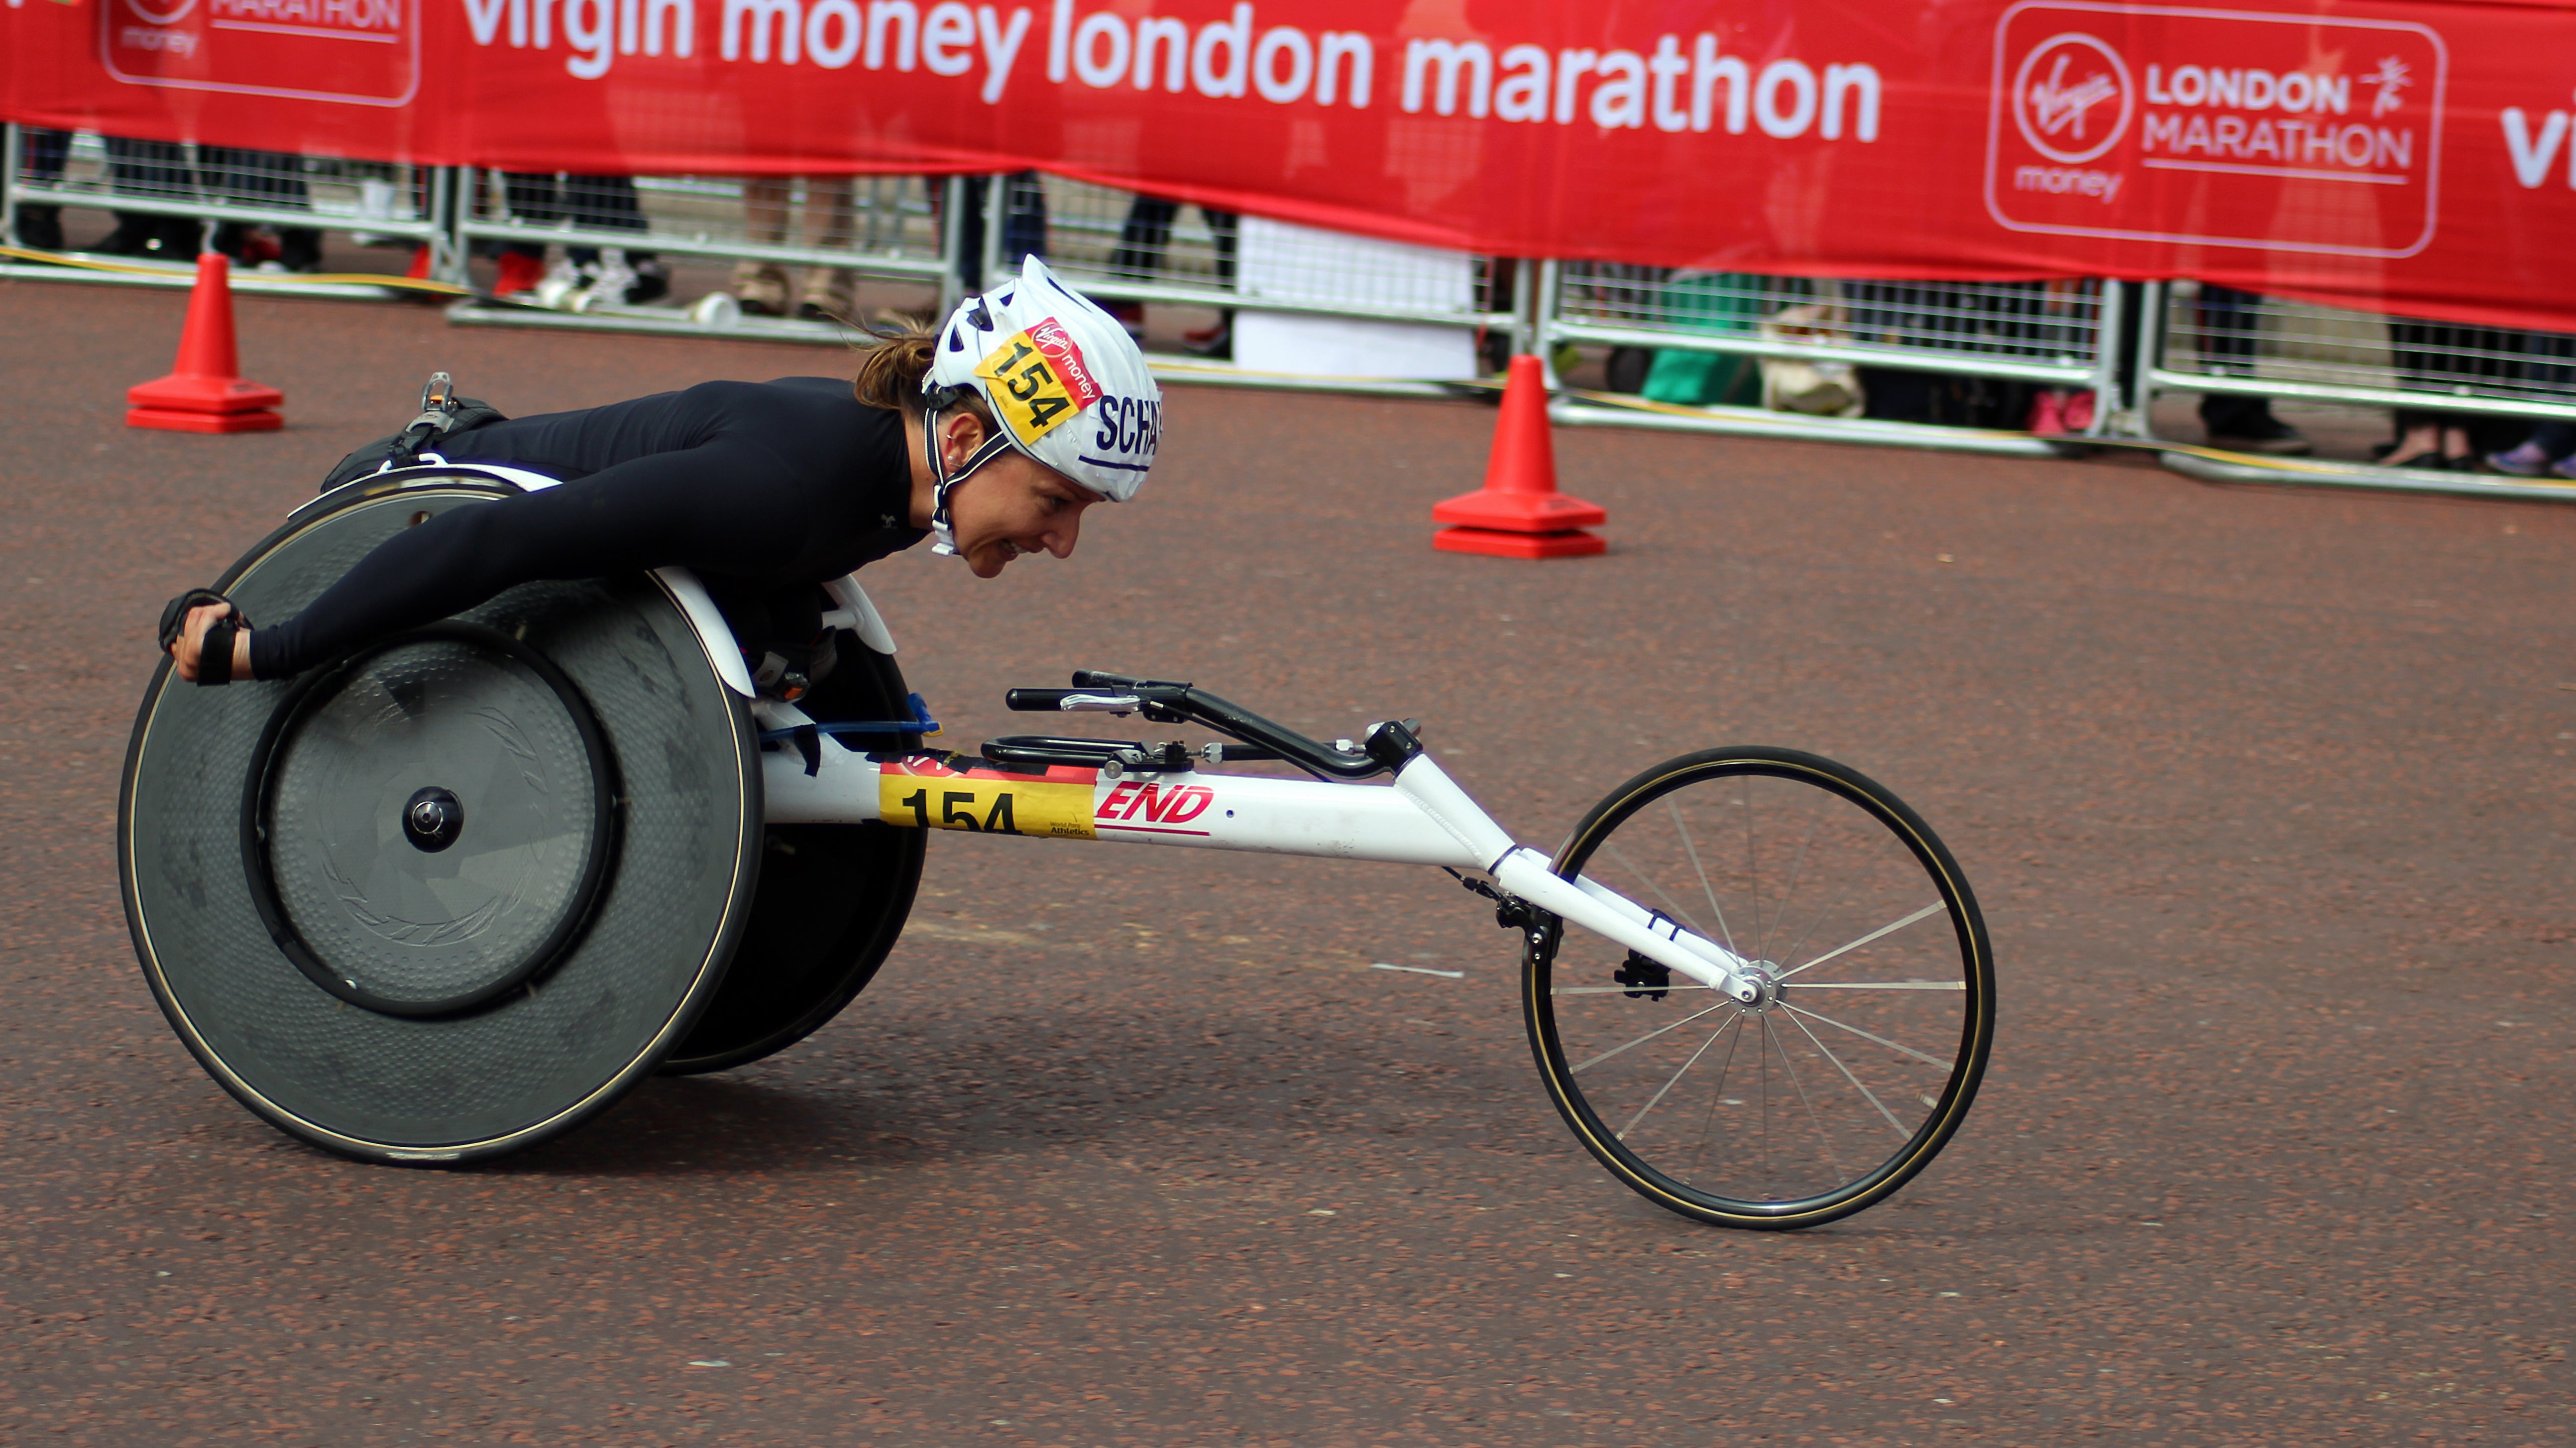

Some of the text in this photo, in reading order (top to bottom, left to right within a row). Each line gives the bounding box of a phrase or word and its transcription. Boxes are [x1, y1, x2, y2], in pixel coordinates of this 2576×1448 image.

[122, 27, 199, 59] money
[463, 0, 1882, 143] virgin money london marathon
[2146, 65, 2351, 115] LONDON
[2142, 113, 2412, 169] MARATHON
[2015, 166, 2124, 204] money
[1036, 327, 1069, 350] Virgin
[994, 342, 1070, 429] 154
[1061, 354, 1096, 399] money
[1096, 395, 1162, 456] SCHA
[902, 789, 1023, 836] 154
[1095, 781, 1214, 824] END
[1051, 827, 1089, 836] Athletics
